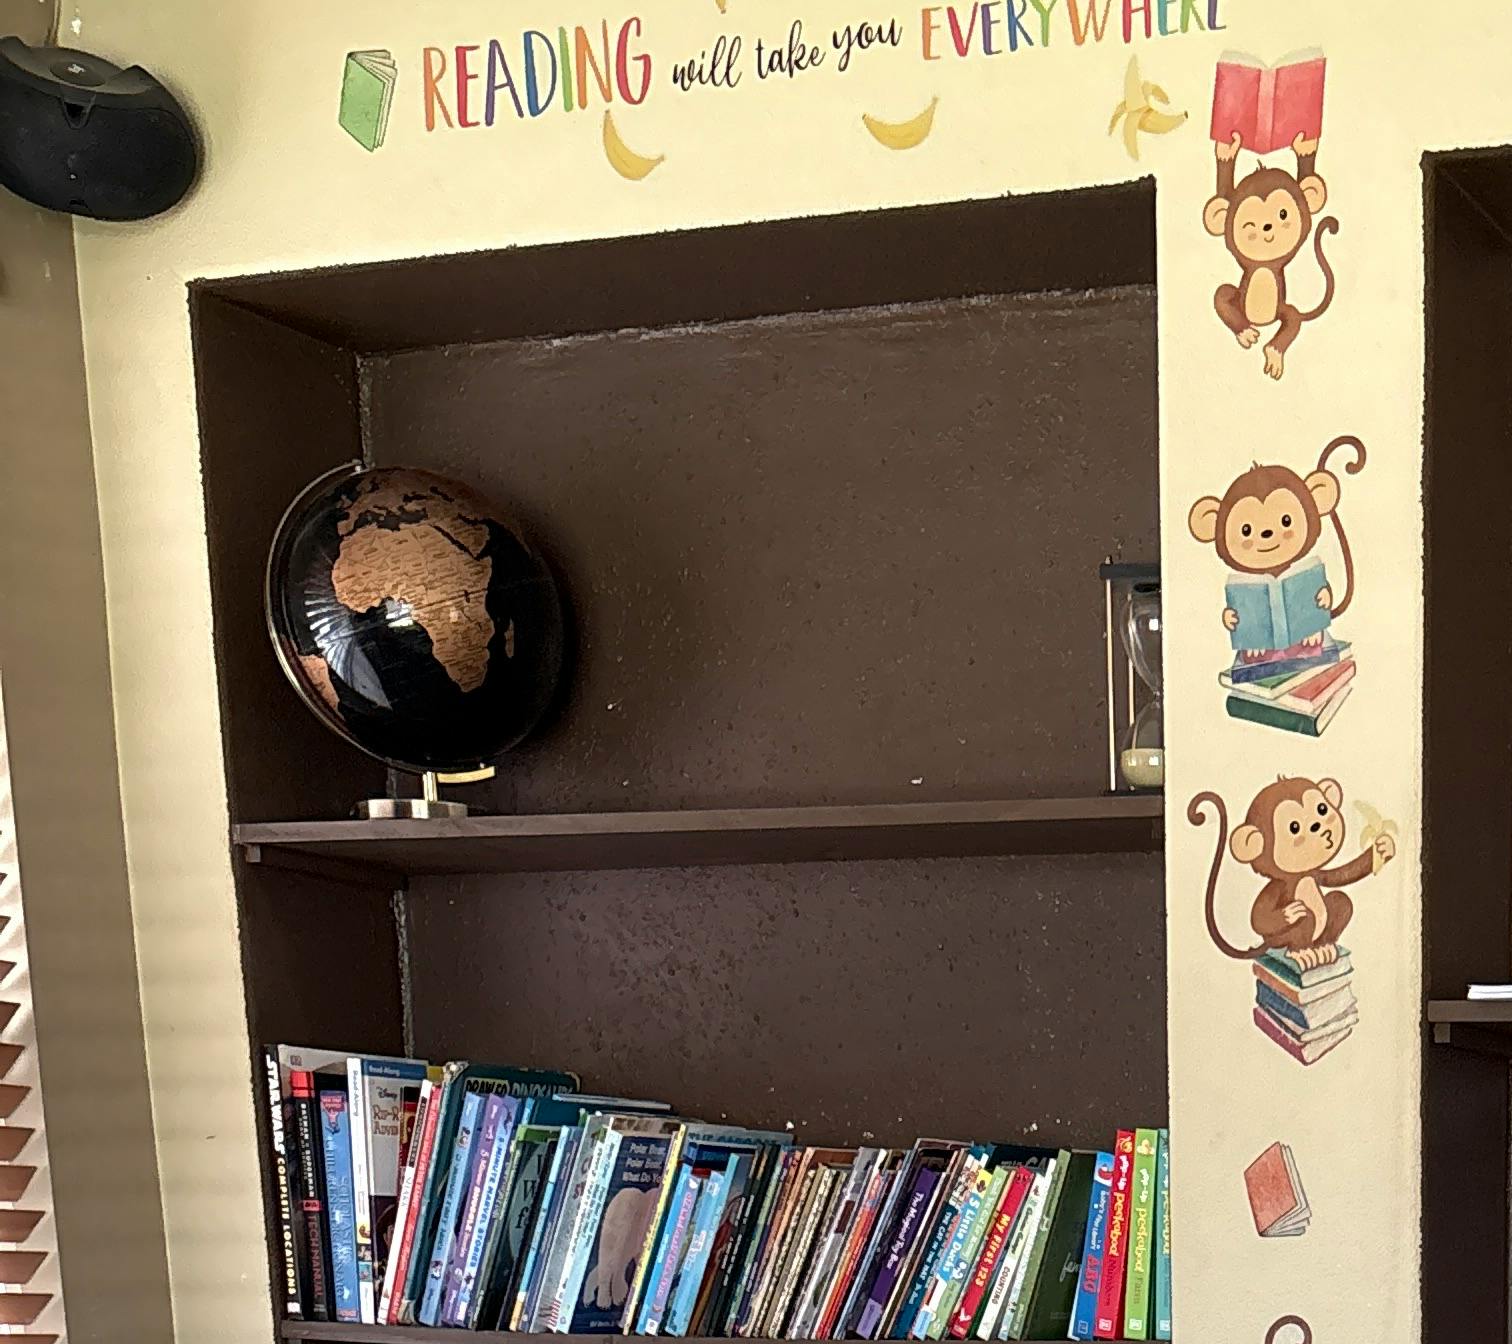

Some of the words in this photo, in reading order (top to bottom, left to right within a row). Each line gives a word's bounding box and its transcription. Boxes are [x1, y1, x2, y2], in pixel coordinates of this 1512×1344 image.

[423, 17, 652, 132] READING
[673, 35, 742, 92] will
[756, 19, 827, 80] take
[832, 17, 903, 72] you
[265, 1054, 281, 1104] STAR
[270, 1103, 285, 1155] WARS
[276, 1157, 290, 1219] COMPLETE
[1116, 1155, 1129, 1190] pop-up
[1138, 1168, 1149, 1202] pop-up
[479, 1185, 494, 1224] MARVEL
[911, 1191, 923, 1207] The
[967, 1197, 978, 1208] 5
[896, 1206, 917, 1240] Magical
[935, 1225, 945, 1240] CAT
[955, 1208, 975, 1240] Little
[995, 1213, 1010, 1233] My
[281, 1225, 297, 1295] LOCATIONS
[469, 1227, 484, 1267] STORIES
[885, 1253, 898, 1270] Box
[890, 1238, 904, 1254] Toy
[942, 1241, 962, 1273] Ducks
[982, 1233, 1003, 1264] First
[919, 1264, 930, 1279] HAT
[973, 1265, 989, 1286] 123
[990, 1265, 1011, 1304] COUNTING
[1082, 1254, 1100, 1293] ABC
